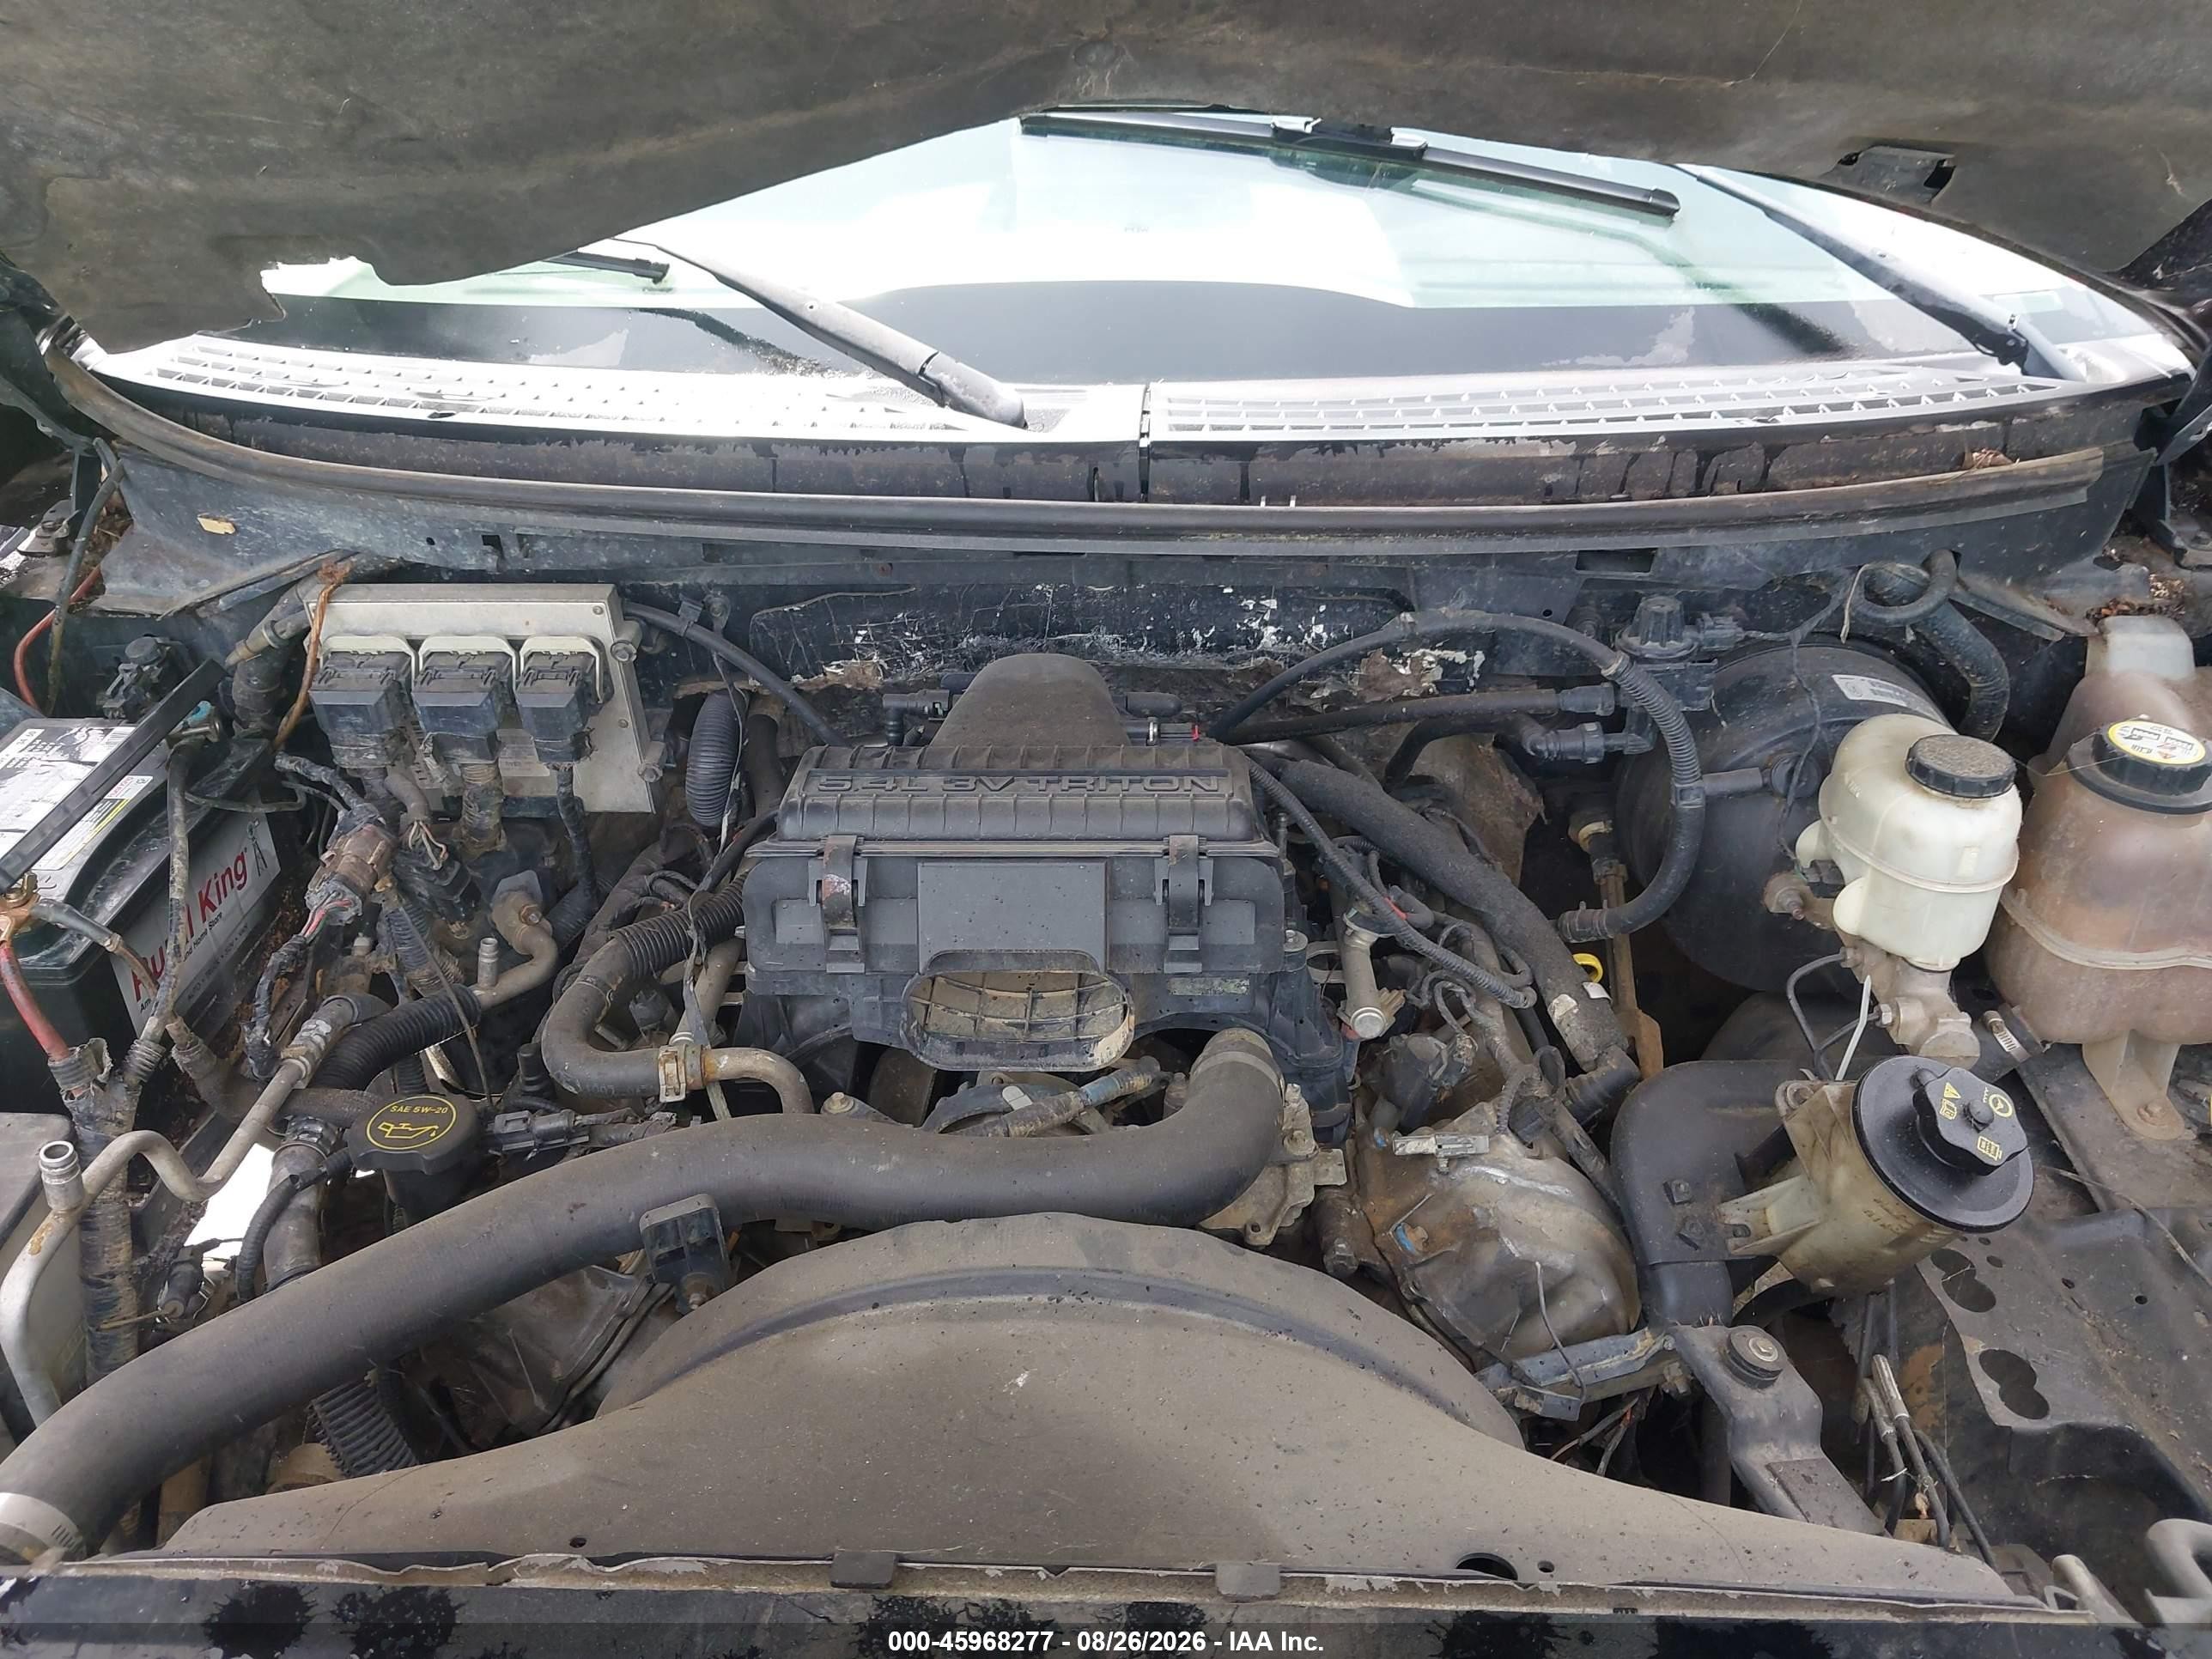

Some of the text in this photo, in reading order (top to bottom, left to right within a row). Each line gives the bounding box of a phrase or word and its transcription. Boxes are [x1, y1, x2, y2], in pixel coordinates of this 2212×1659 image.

[817, 775, 1218, 793] 5.4L 3V TRITON
[198, 850, 248, 923] King
[413, 1105, 447, 1114] 5W-20
